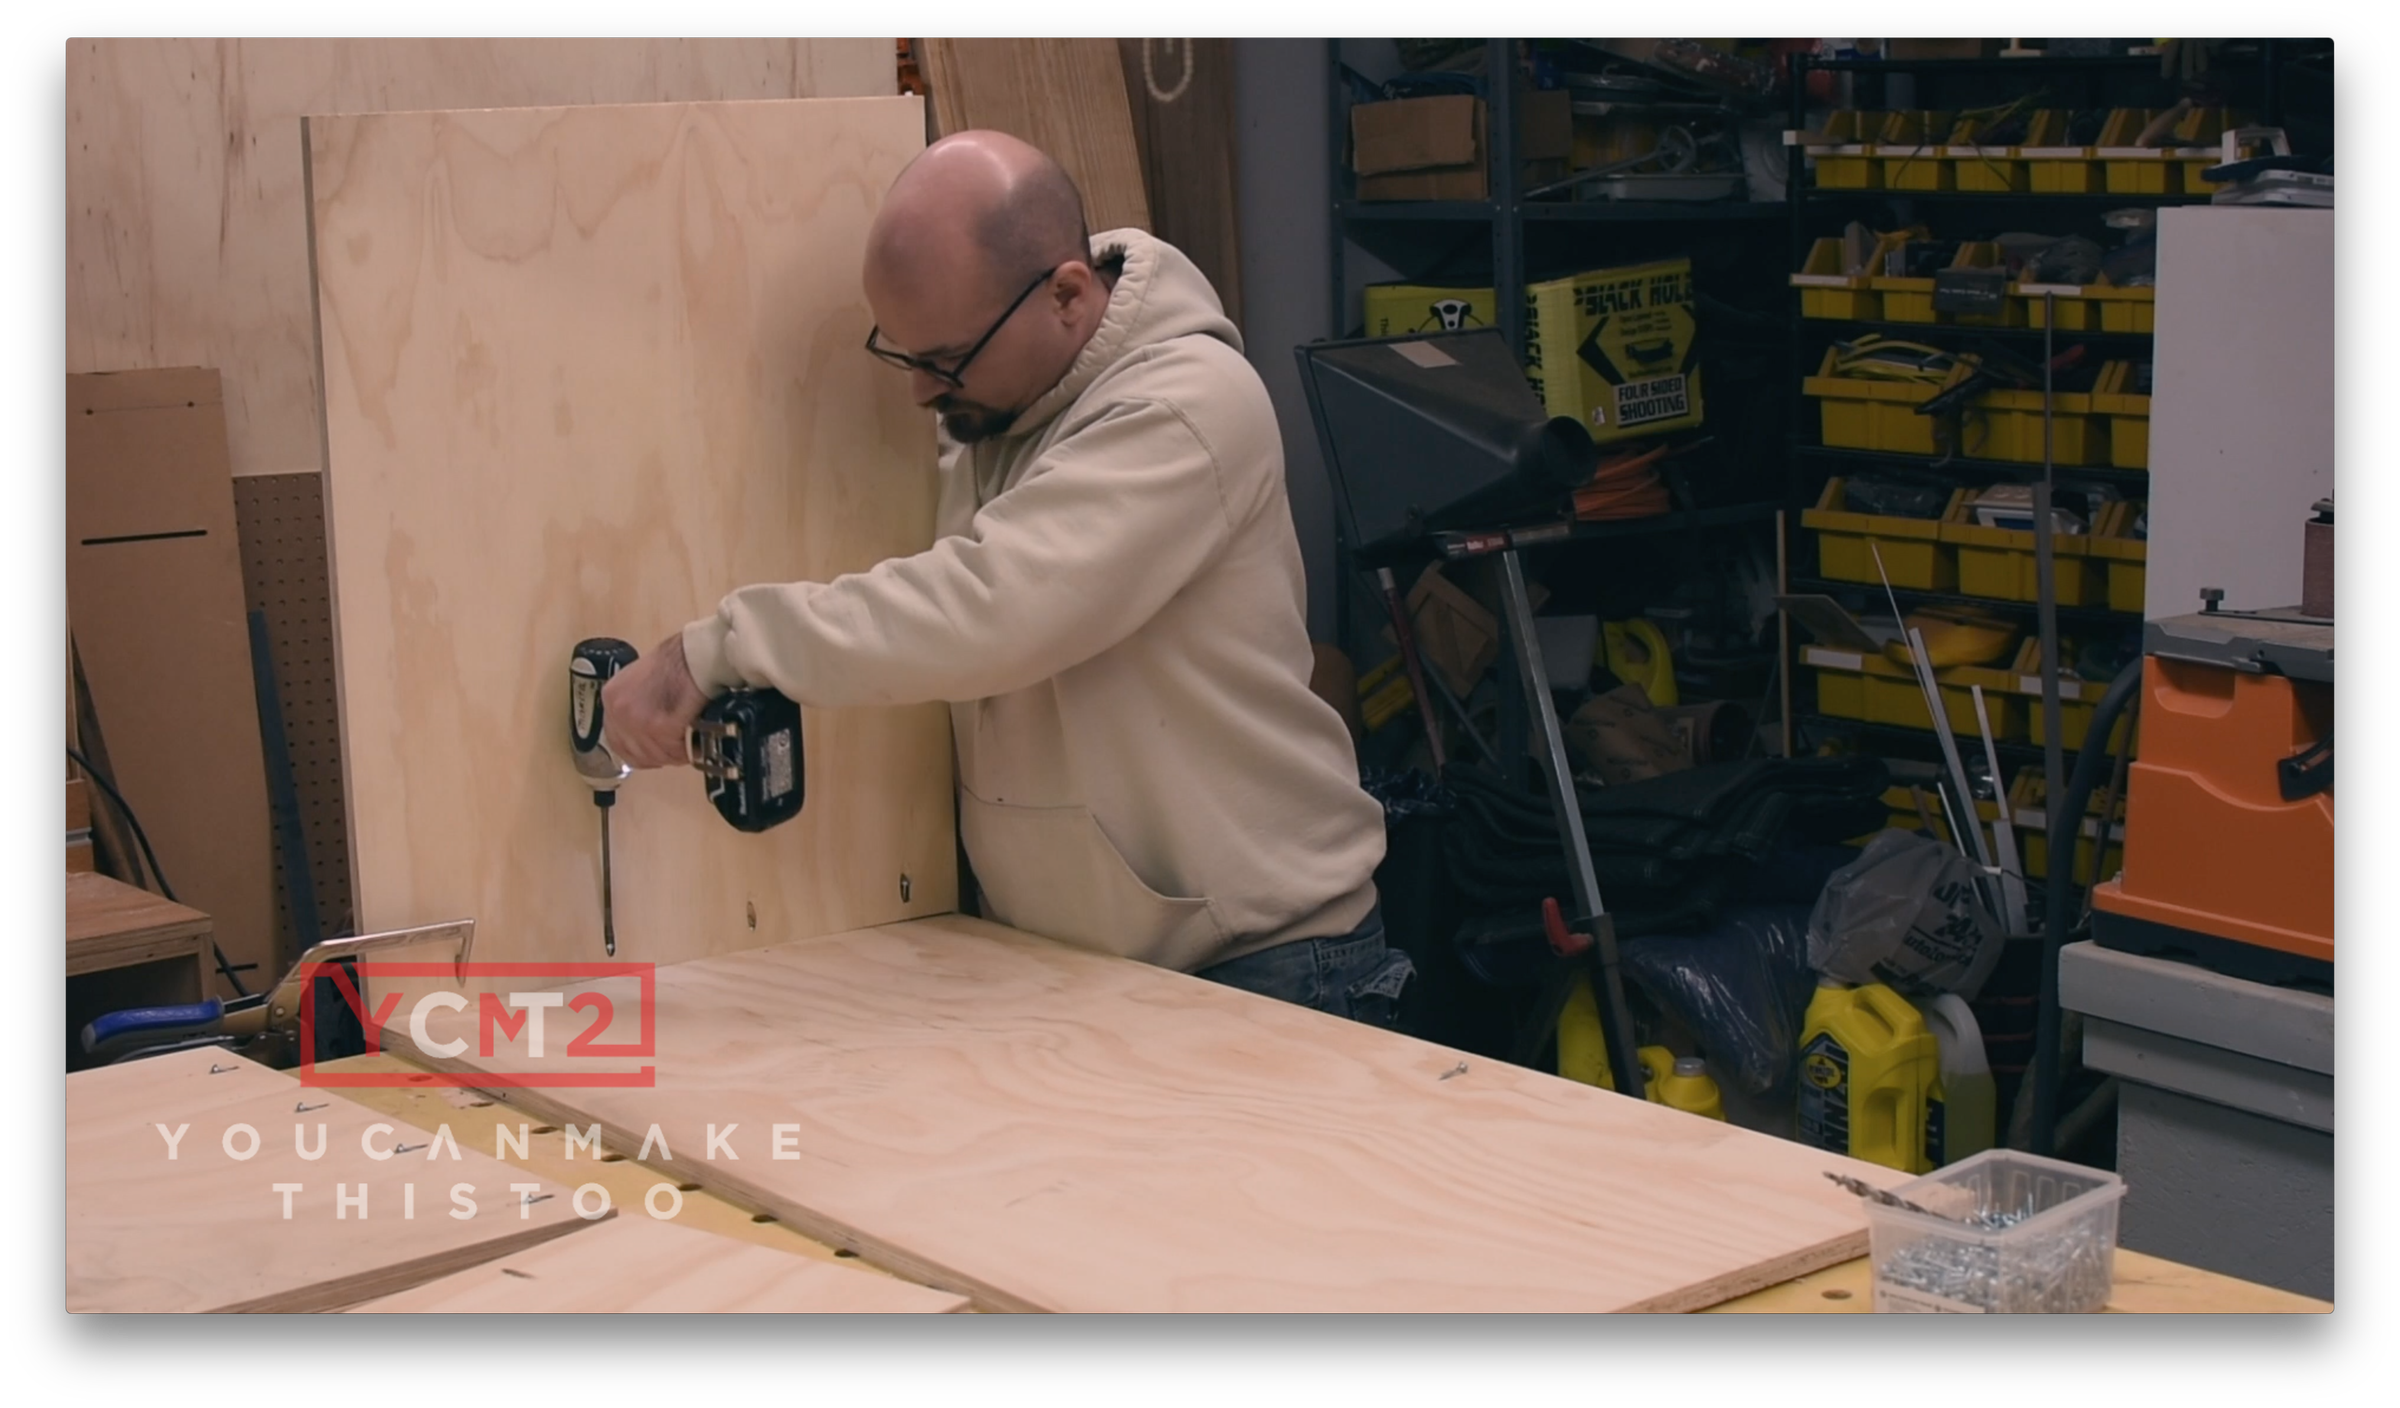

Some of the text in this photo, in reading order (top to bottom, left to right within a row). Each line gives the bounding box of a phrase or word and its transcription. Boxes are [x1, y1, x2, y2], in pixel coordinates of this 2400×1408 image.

[1618, 376, 1683, 403] FOUR SIDED
[1618, 394, 1685, 422] SHOOTING
